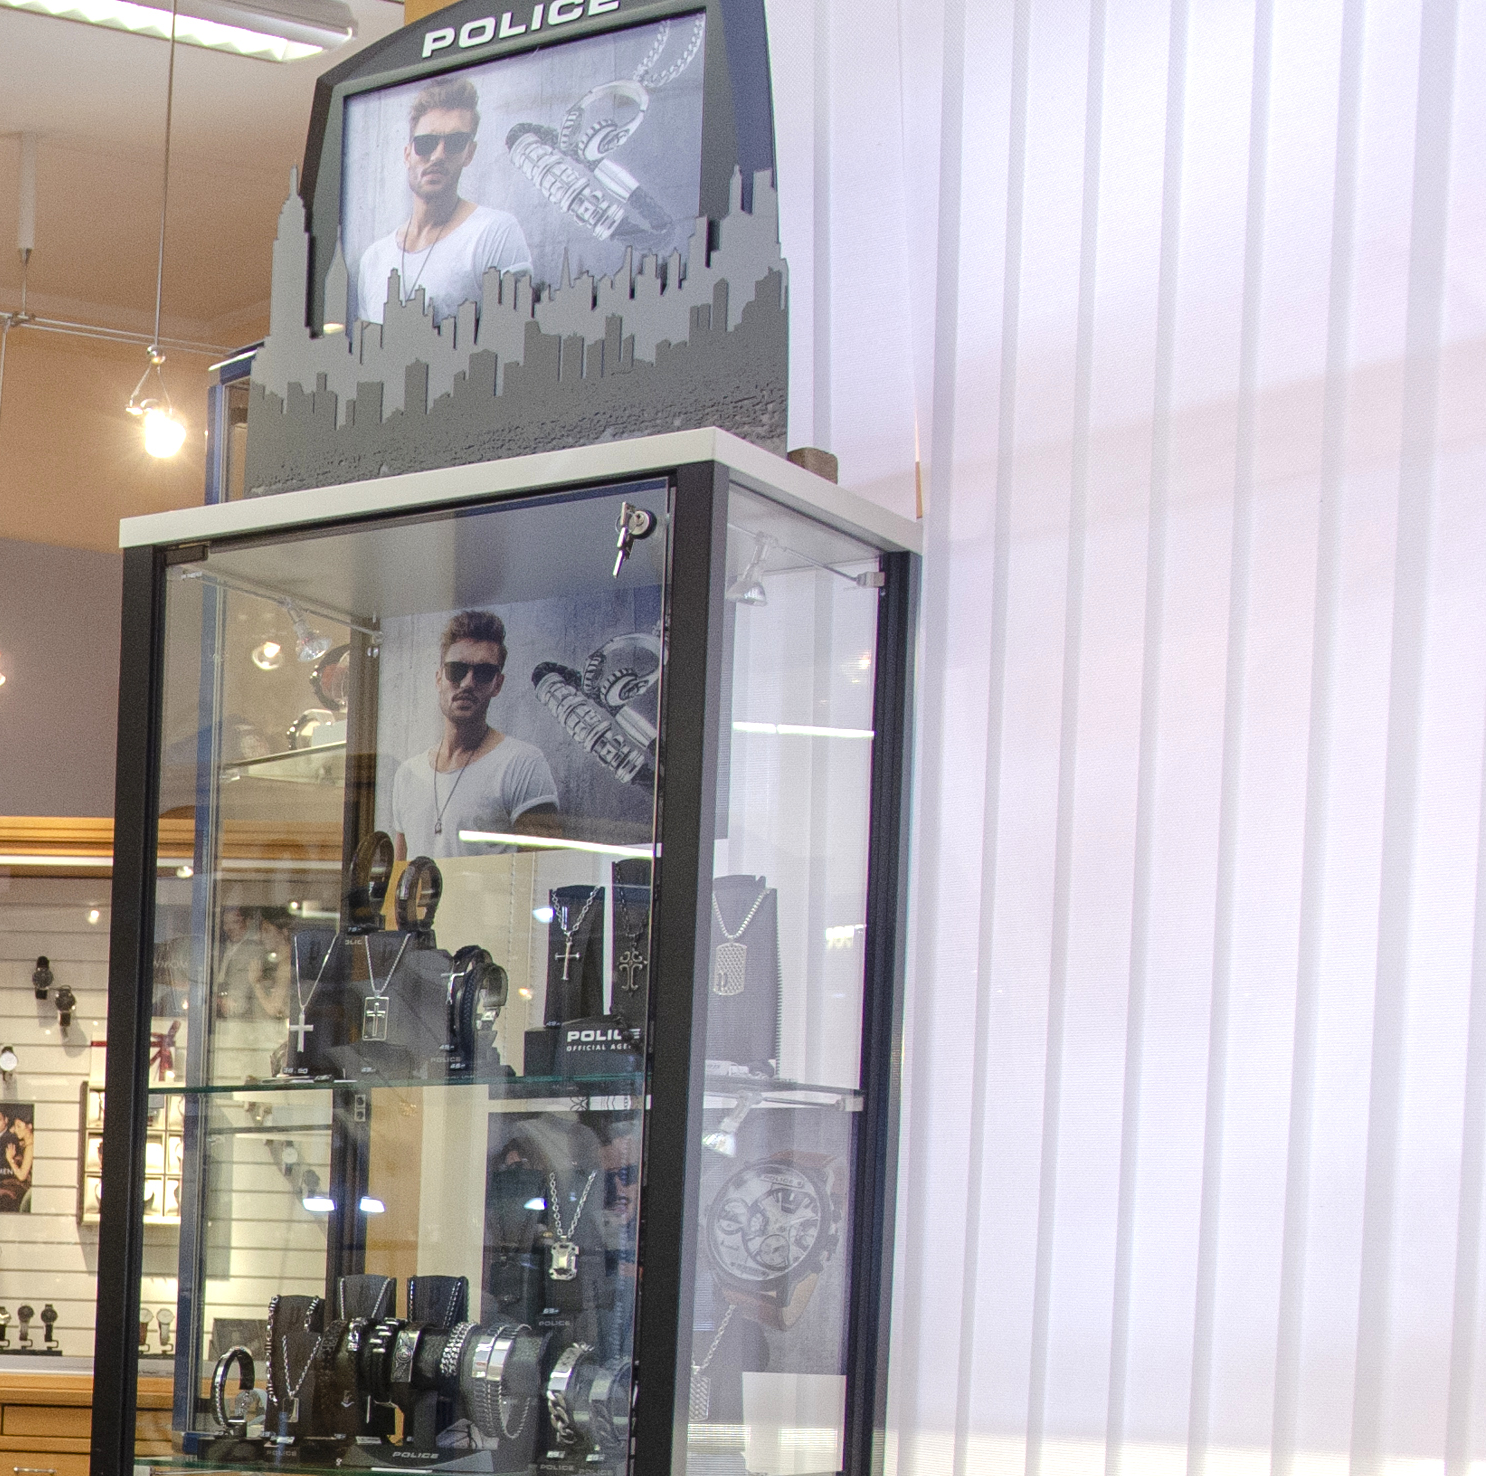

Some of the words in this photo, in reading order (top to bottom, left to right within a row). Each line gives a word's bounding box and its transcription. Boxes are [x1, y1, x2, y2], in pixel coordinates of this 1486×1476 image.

[421, 0, 620, 58] POLICE
[566, 1044, 606, 1052] OFFICIAL
[392, 1451, 440, 1459] POLICE
